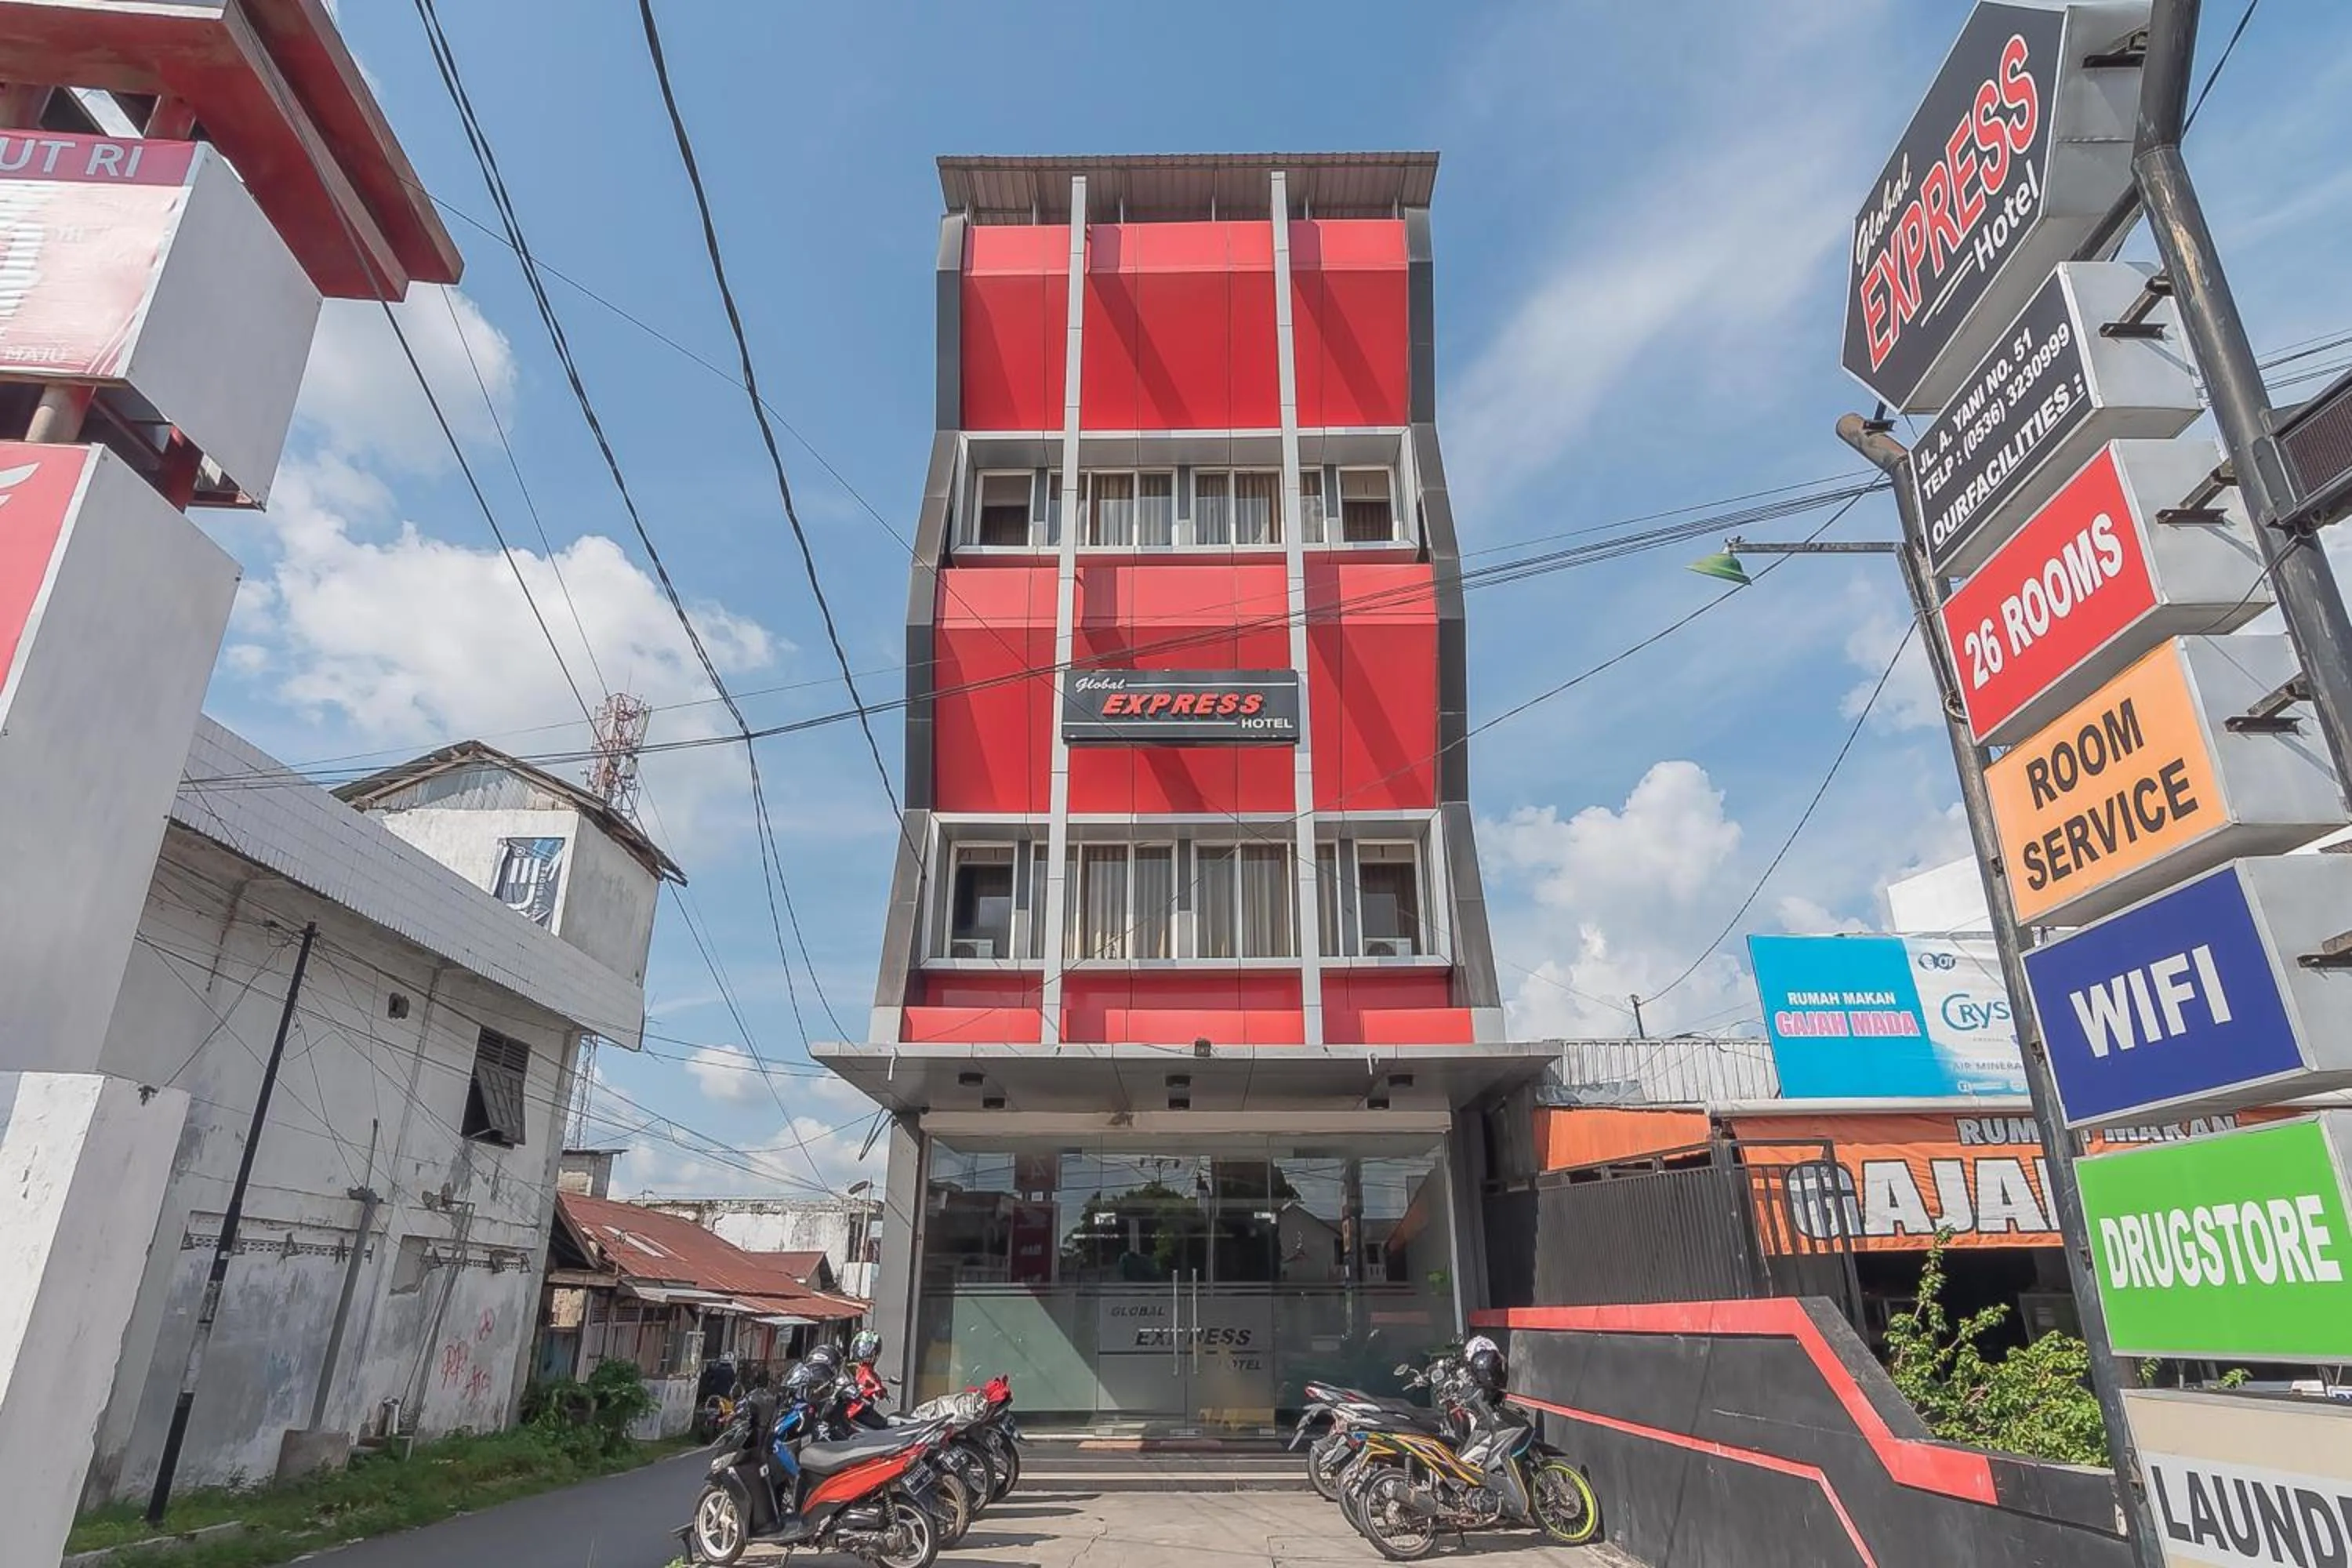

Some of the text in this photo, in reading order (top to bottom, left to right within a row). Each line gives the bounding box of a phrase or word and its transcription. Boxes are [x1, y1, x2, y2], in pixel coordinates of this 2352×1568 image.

[85, 143, 143, 177] RI
[1856, 152, 1911, 277] Global
[1860, 33, 2038, 374] EXPRESS
[1973, 159, 2039, 272] Hotel
[1918, 326, 2033, 475] JL. A. YANI NO. 51
[1922, 456, 1955, 500] TELP
[1962, 397, 2006, 460] (0536)
[2006, 322, 2070, 407] 3230999
[1932, 383, 2071, 546] OURFACILITIES
[1965, 512, 2124, 690] 26 ROOMS
[1075, 677, 1126, 692] Global
[1101, 693, 1265, 717] EXPRESS
[1241, 717, 1293, 729] HOTEL
[2025, 697, 2144, 811] ROOM
[2023, 758, 2198, 891] SERVICE
[1775, 1011, 1921, 1037] GAJAH MADA
[1787, 991, 1896, 1005] RUMAH MAKAN
[2069, 944, 2233, 1058] WIFI
[1976, 1062, 2023, 1071] MINERA
[2099, 1194, 2343, 1290] DRUGSTORE
[1110, 1305, 1166, 1317] GLOBAL
